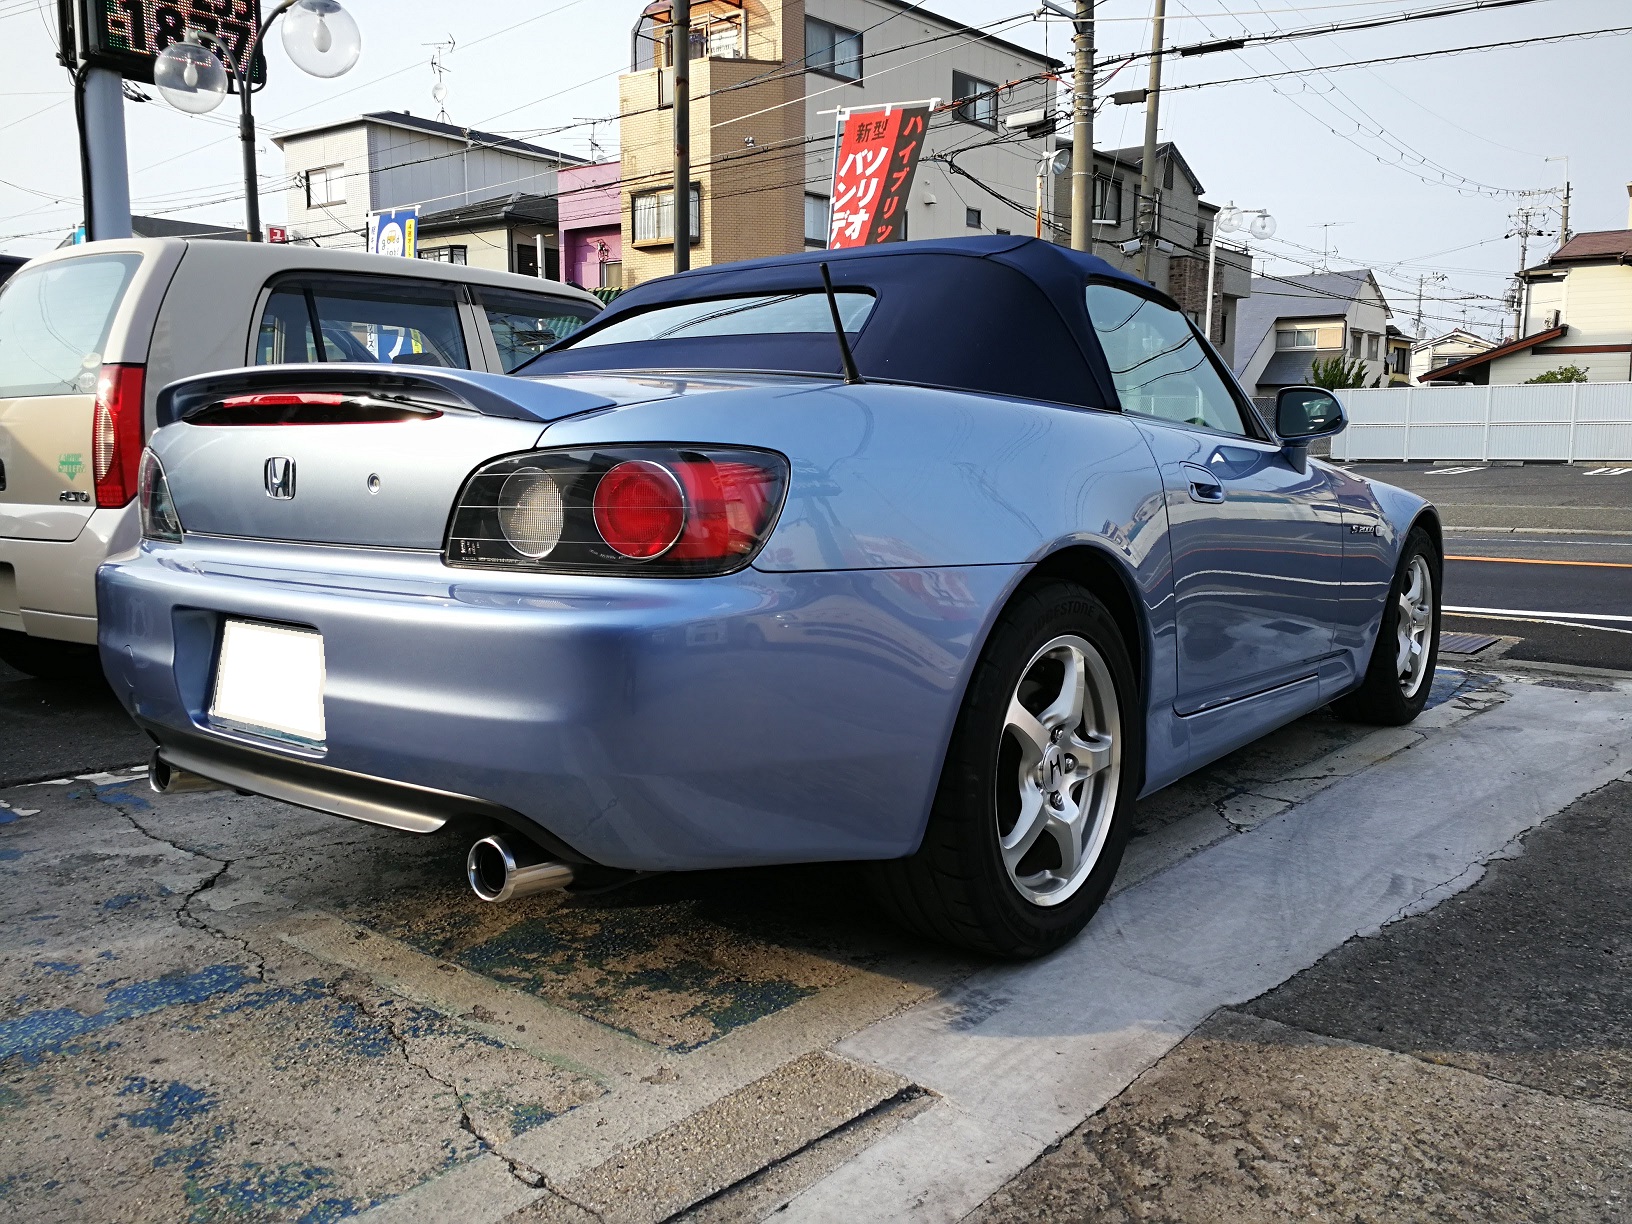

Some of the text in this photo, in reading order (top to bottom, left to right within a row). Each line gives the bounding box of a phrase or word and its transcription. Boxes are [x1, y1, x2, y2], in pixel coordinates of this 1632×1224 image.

[856, 119, 888, 143] 新型
[845, 147, 889, 240] ソリオ
[59, 490, 90, 503] ALTO
